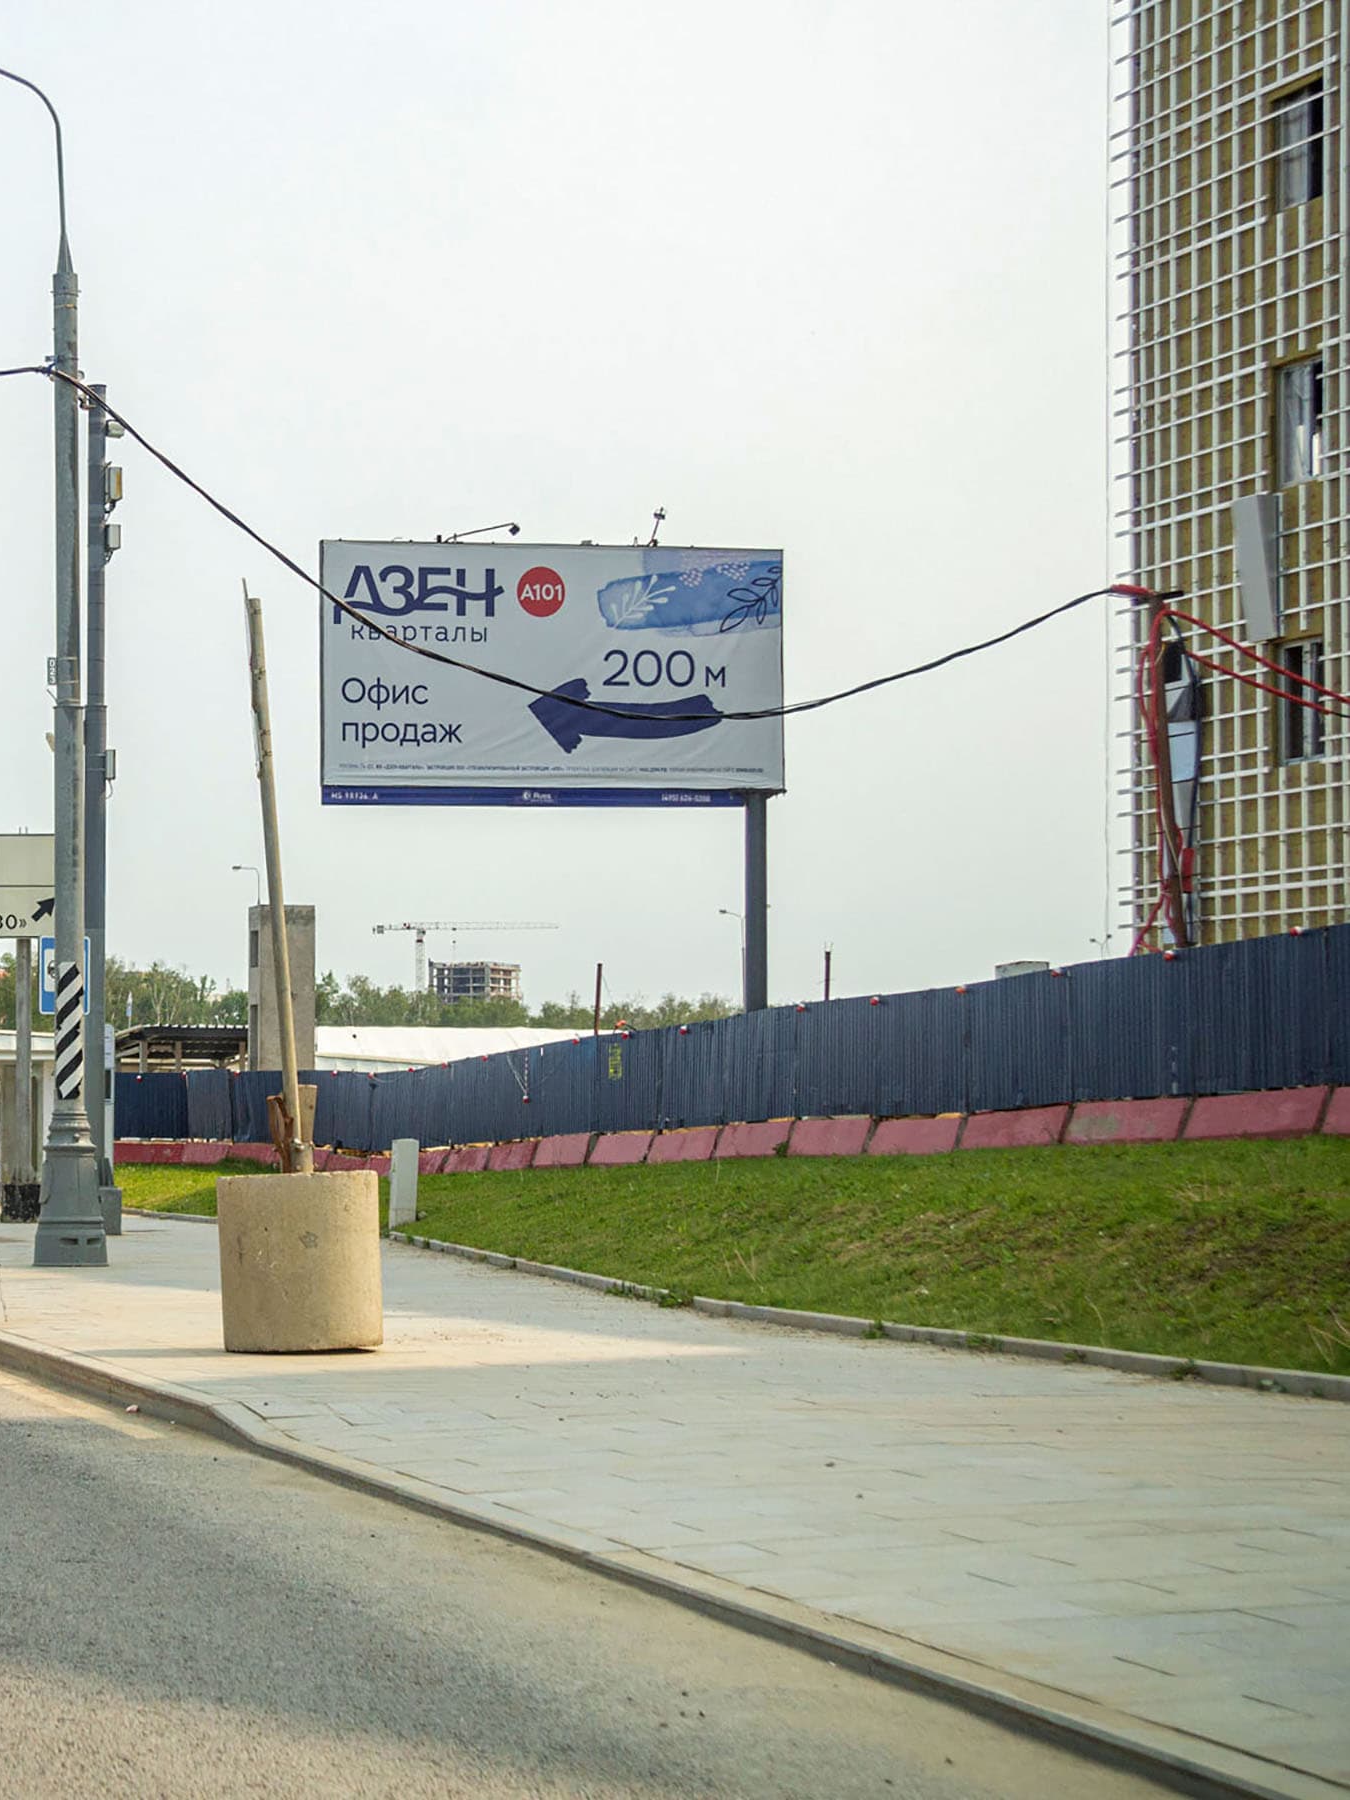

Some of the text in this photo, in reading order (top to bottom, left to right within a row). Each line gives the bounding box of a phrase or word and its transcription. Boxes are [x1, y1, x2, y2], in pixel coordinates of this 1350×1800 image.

[520, 583, 563, 602] A101
[351, 624, 487, 643] кварталы
[602, 649, 726, 688] 200 м
[341, 676, 429, 711] Офис
[342, 722, 463, 748] продаж
